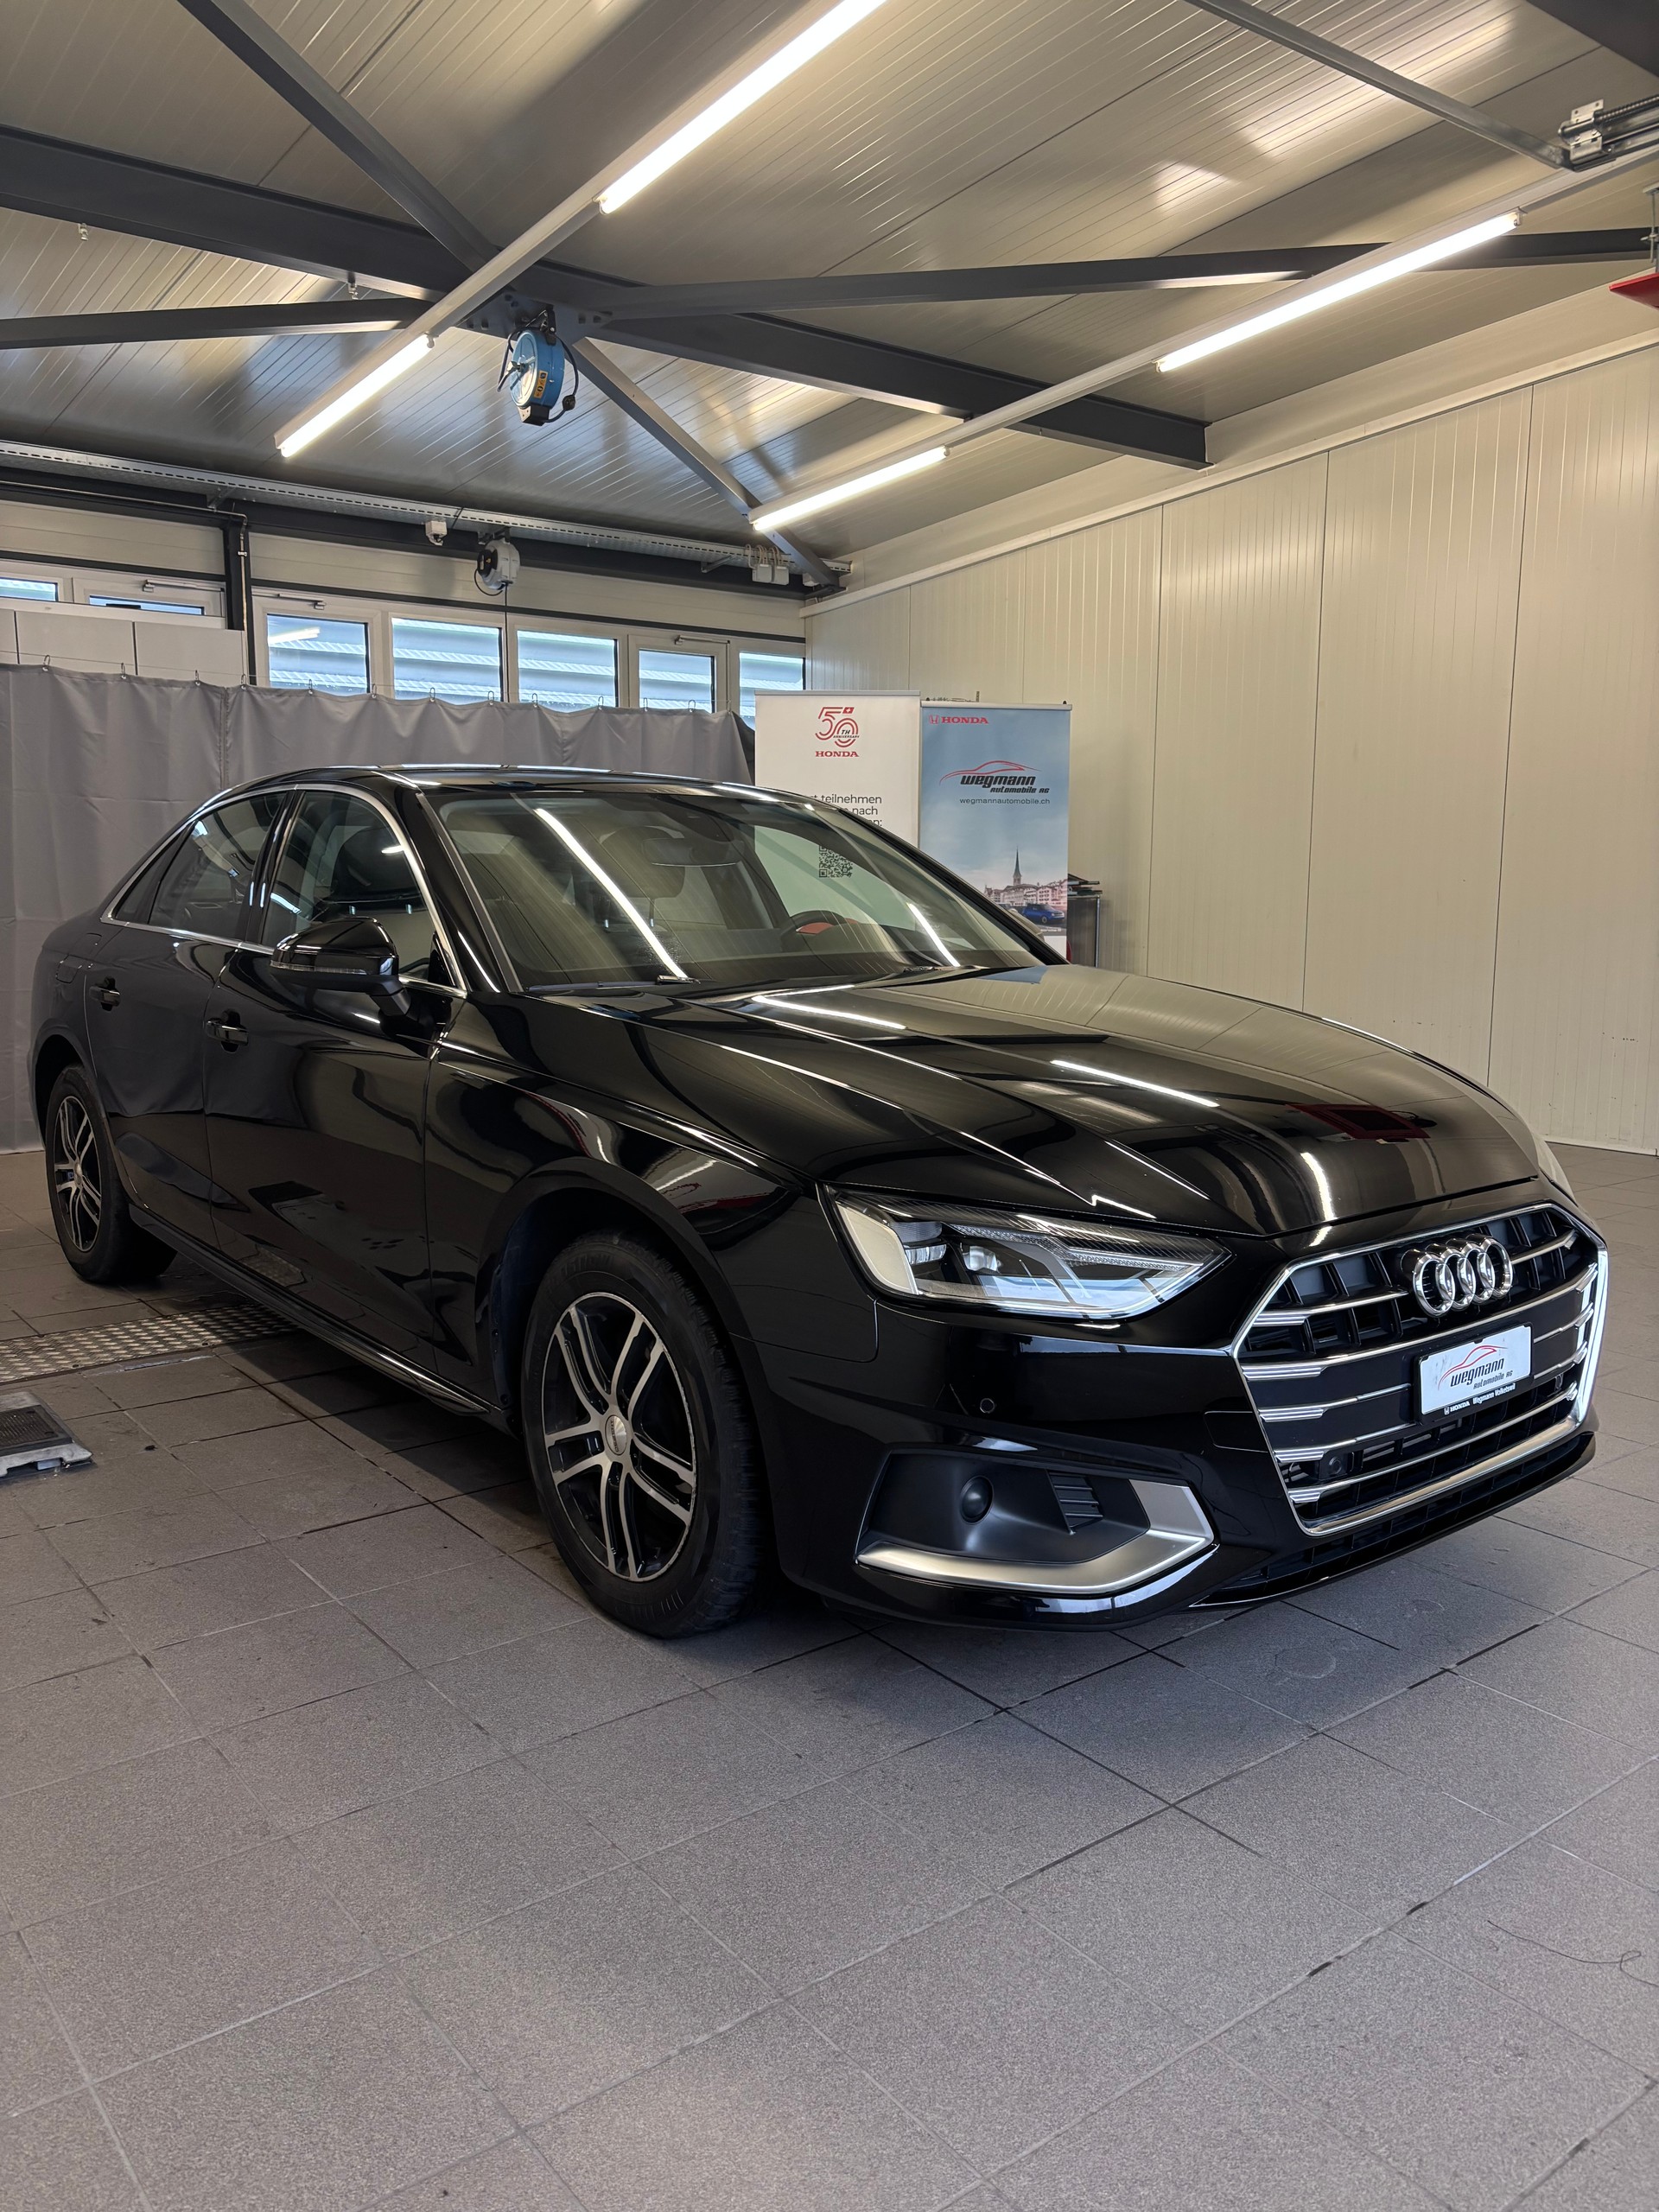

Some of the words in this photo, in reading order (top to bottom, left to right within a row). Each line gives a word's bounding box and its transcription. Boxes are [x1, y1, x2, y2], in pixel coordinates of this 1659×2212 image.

[961, 775, 1036, 788] wegmann
[821, 794, 882, 804] teilnehmen
[852, 806, 878, 815] nach
[1451, 1358, 1504, 1387] wegmann
[1450, 1401, 1471, 1412] HONDA
